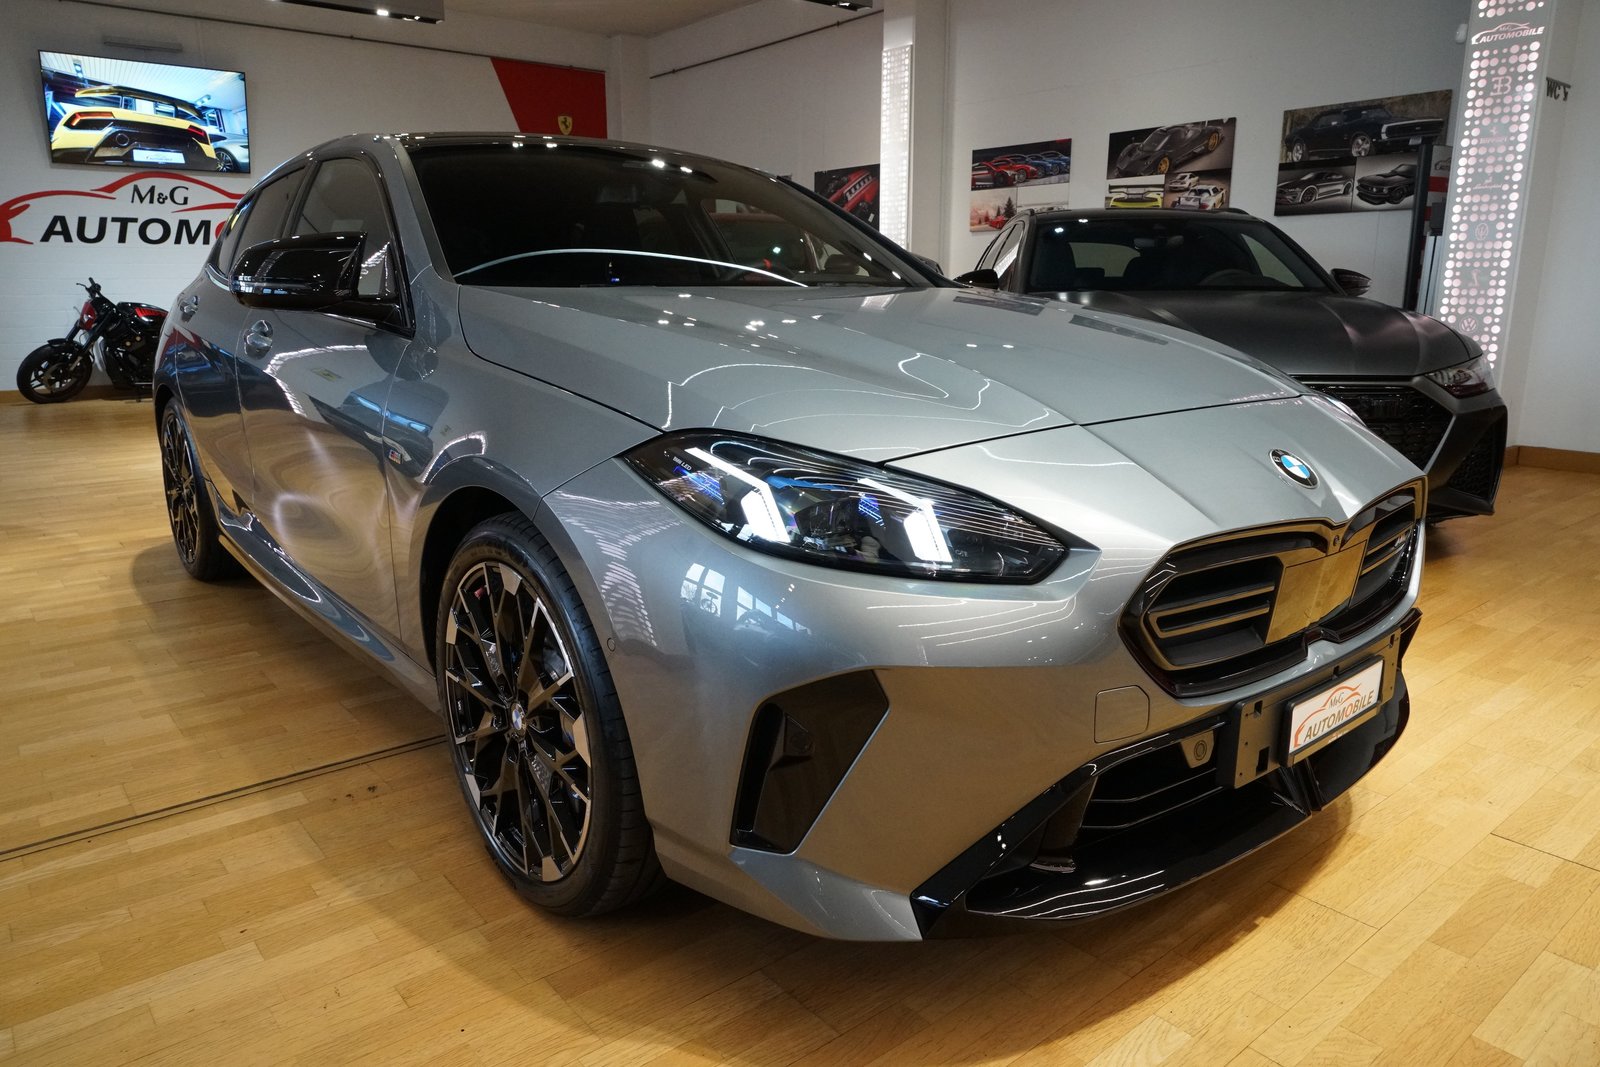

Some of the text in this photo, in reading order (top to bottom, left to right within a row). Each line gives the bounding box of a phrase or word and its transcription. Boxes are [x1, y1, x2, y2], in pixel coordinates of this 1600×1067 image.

[1480, 26, 1545, 43] AUTOMOBILE
[1546, 79, 1560, 100] WC
[130, 184, 189, 205] M&G
[40, 215, 227, 245] AUTOM
[681, 462, 692, 471] LED
[1304, 689, 1375, 743] AUTOMOBILE
